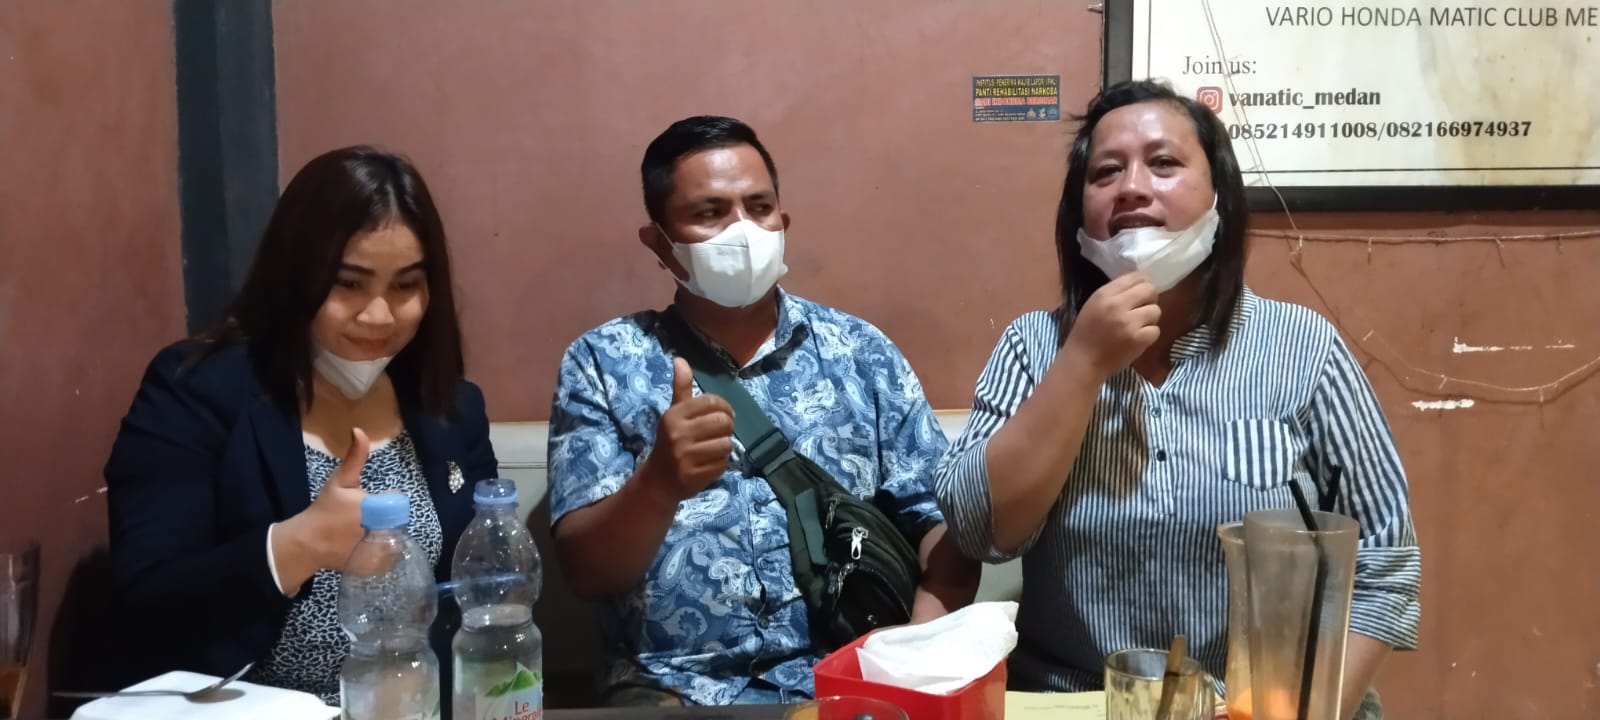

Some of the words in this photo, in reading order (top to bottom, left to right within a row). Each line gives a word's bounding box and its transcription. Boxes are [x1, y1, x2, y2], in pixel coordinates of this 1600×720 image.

[1265, 6, 1333, 27] VARIO
[1341, 6, 1422, 27] HONDA
[1430, 7, 1497, 27] MATIC
[1503, 7, 1558, 27] CLUB
[1565, 7, 1598, 27] ME
[1182, 55, 1223, 75] Join
[1230, 59, 1257, 75] us:
[976, 88, 991, 97] PANTI
[993, 87, 1030, 97] REHABILITASI
[1031, 87, 1057, 96] NARKOBA
[1229, 88, 1381, 110] vanatic_medan
[1228, 121, 1532, 141] 085214911008/082166974937
[514, 701, 529, 715] Le
